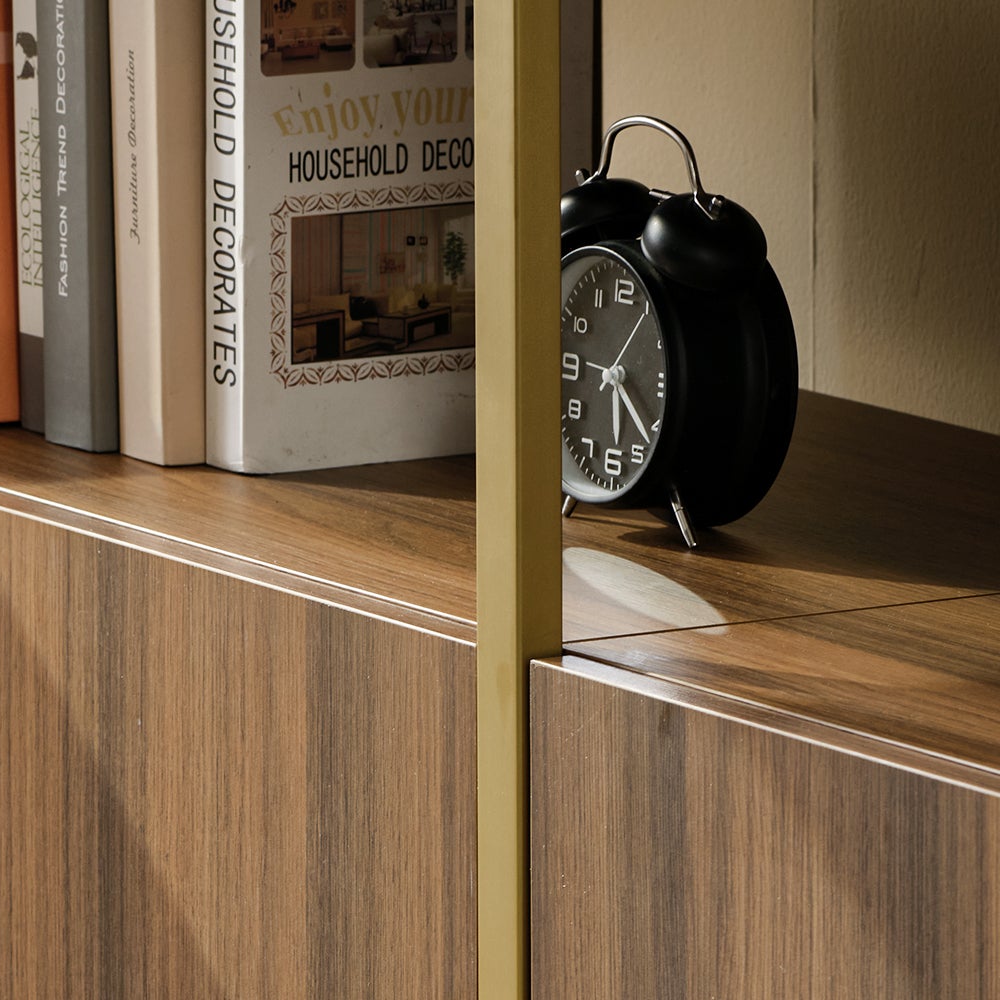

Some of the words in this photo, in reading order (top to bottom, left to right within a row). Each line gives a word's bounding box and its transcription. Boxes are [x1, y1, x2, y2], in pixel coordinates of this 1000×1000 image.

[55, 0, 67, 115] DECORATI
[125, 49, 138, 148] Decoration
[272, 81, 381, 141] Enjoy
[391, 86, 475, 138] your
[57, 124, 68, 197] TREND
[289, 142, 409, 184] HOUSEHOLD
[422, 137, 475, 172] DECO
[128, 152, 142, 245] Furniture
[58, 205, 69, 298] FASHION
[213, 179, 237, 388] DECORATES
[594, 288, 603, 309] 11
[614, 278, 635, 305] 12
[573, 316, 588, 334] 10
[562, 352, 580, 381] 9
[568, 398, 582, 420] 8
[581, 437, 594, 458] 7
[604, 448, 623, 476] 6
[630, 444, 645, 464] 5
